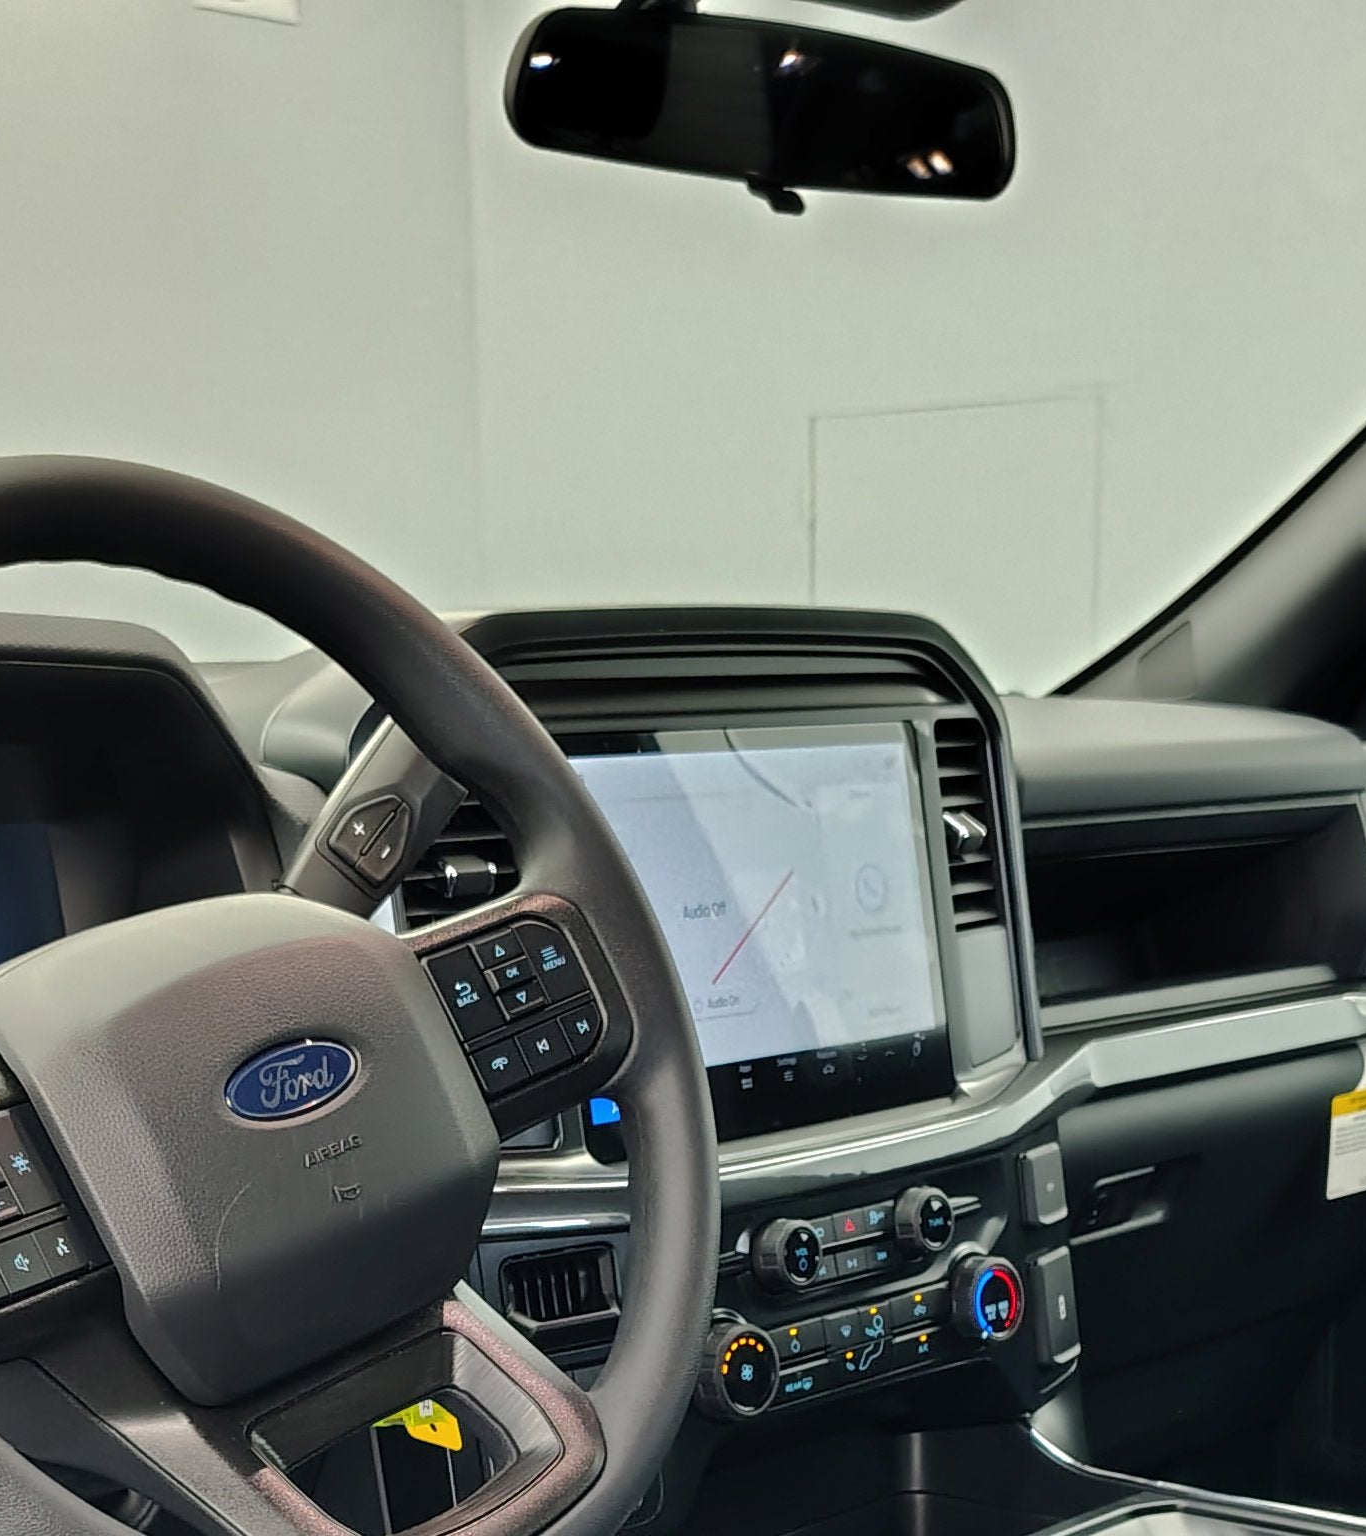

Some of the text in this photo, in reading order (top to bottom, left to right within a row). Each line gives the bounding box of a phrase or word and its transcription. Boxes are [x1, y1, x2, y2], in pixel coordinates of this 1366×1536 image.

[505, 966, 520, 979] OK
[542, 955, 566, 973] MENU
[456, 991, 481, 1008] BACK
[258, 1053, 335, 1109] Ford
[302, 1132, 363, 1170] AIRBAG
